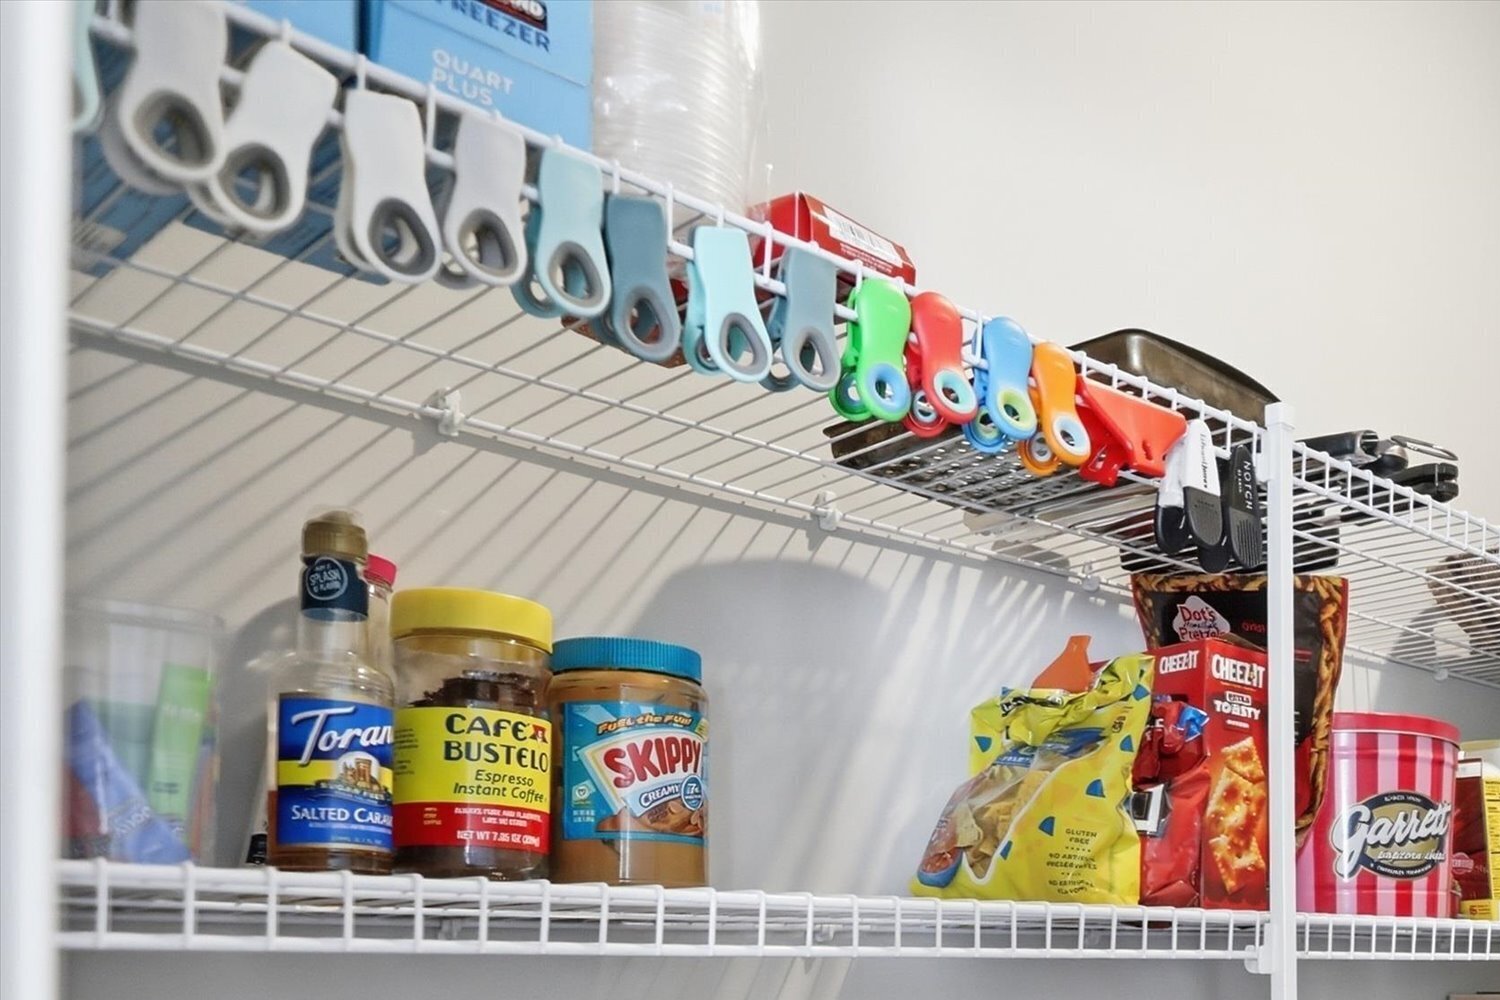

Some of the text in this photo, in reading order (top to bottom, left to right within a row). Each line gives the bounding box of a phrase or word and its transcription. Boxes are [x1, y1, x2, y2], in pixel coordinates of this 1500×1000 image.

[440, 0, 550, 52] REEZER
[433, 49, 514, 94] QUART
[432, 67, 494, 106] PLUS
[1243, 460, 1255, 510] NOTCH
[1180, 606, 1217, 622] Dot's
[1213, 700, 1262, 721] TOASTY
[598, 718, 635, 734] FUEL
[637, 713, 663, 724] the
[444, 740, 549, 773] BUSTELO
[604, 736, 702, 788] SKIPPY
[475, 769, 534, 788] Espresso
[454, 783, 545, 803] Instant Coffee
[640, 784, 682, 807] CREAMY
[291, 805, 350, 821] SALTED
[1065, 828, 1099, 838] GLUTEN
[1069, 837, 1090, 845] FREE
[1332, 801, 1452, 881] Garrett
